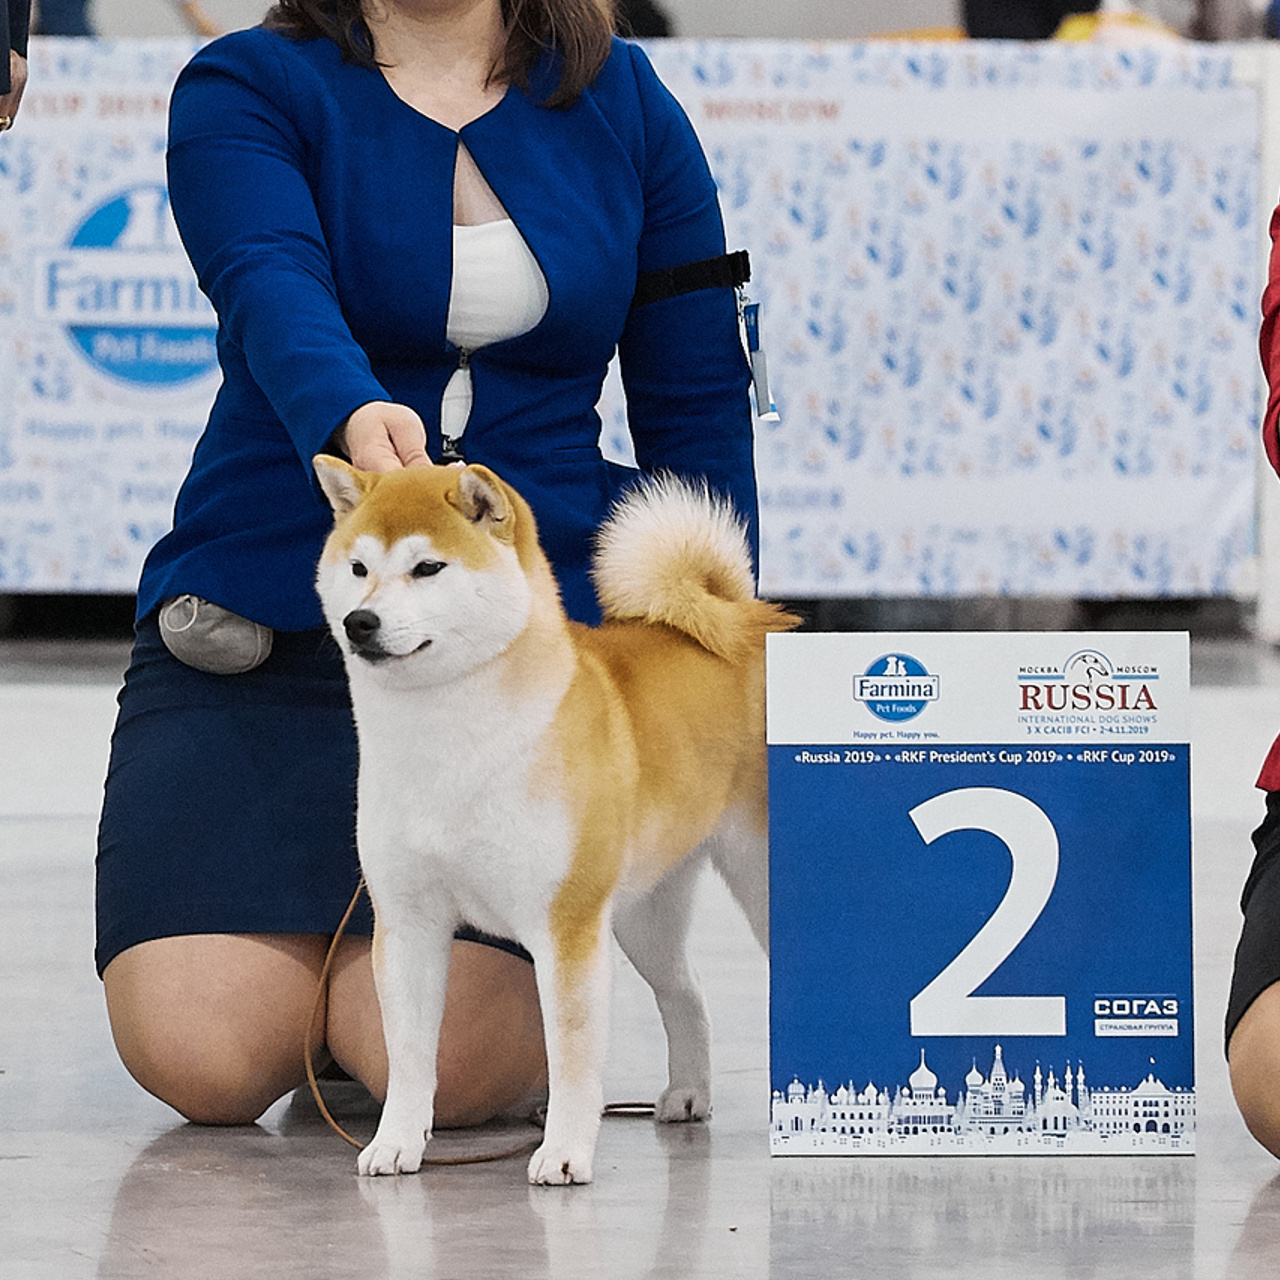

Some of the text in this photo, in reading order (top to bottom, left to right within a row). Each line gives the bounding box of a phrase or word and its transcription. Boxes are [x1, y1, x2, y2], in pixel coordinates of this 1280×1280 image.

[47, 261, 212, 311] Farmi
[859, 679, 933, 697] Farmina
[1019, 684, 1158, 711] RUSSIA
[1018, 715, 1157, 724] INTERNATIONAL DOG SHOWS
[1026, 726, 1032, 734] 3
[1043, 726, 1072, 734] CACIB
[1075, 726, 1090, 734] FCI
[929, 751, 996, 763] President's
[998, 750, 1023, 765] Cup
[1110, 750, 1135, 765] Cup
[908, 786, 1067, 1036] 2
[1094, 1000, 1178, 1015] СОГАЗ
